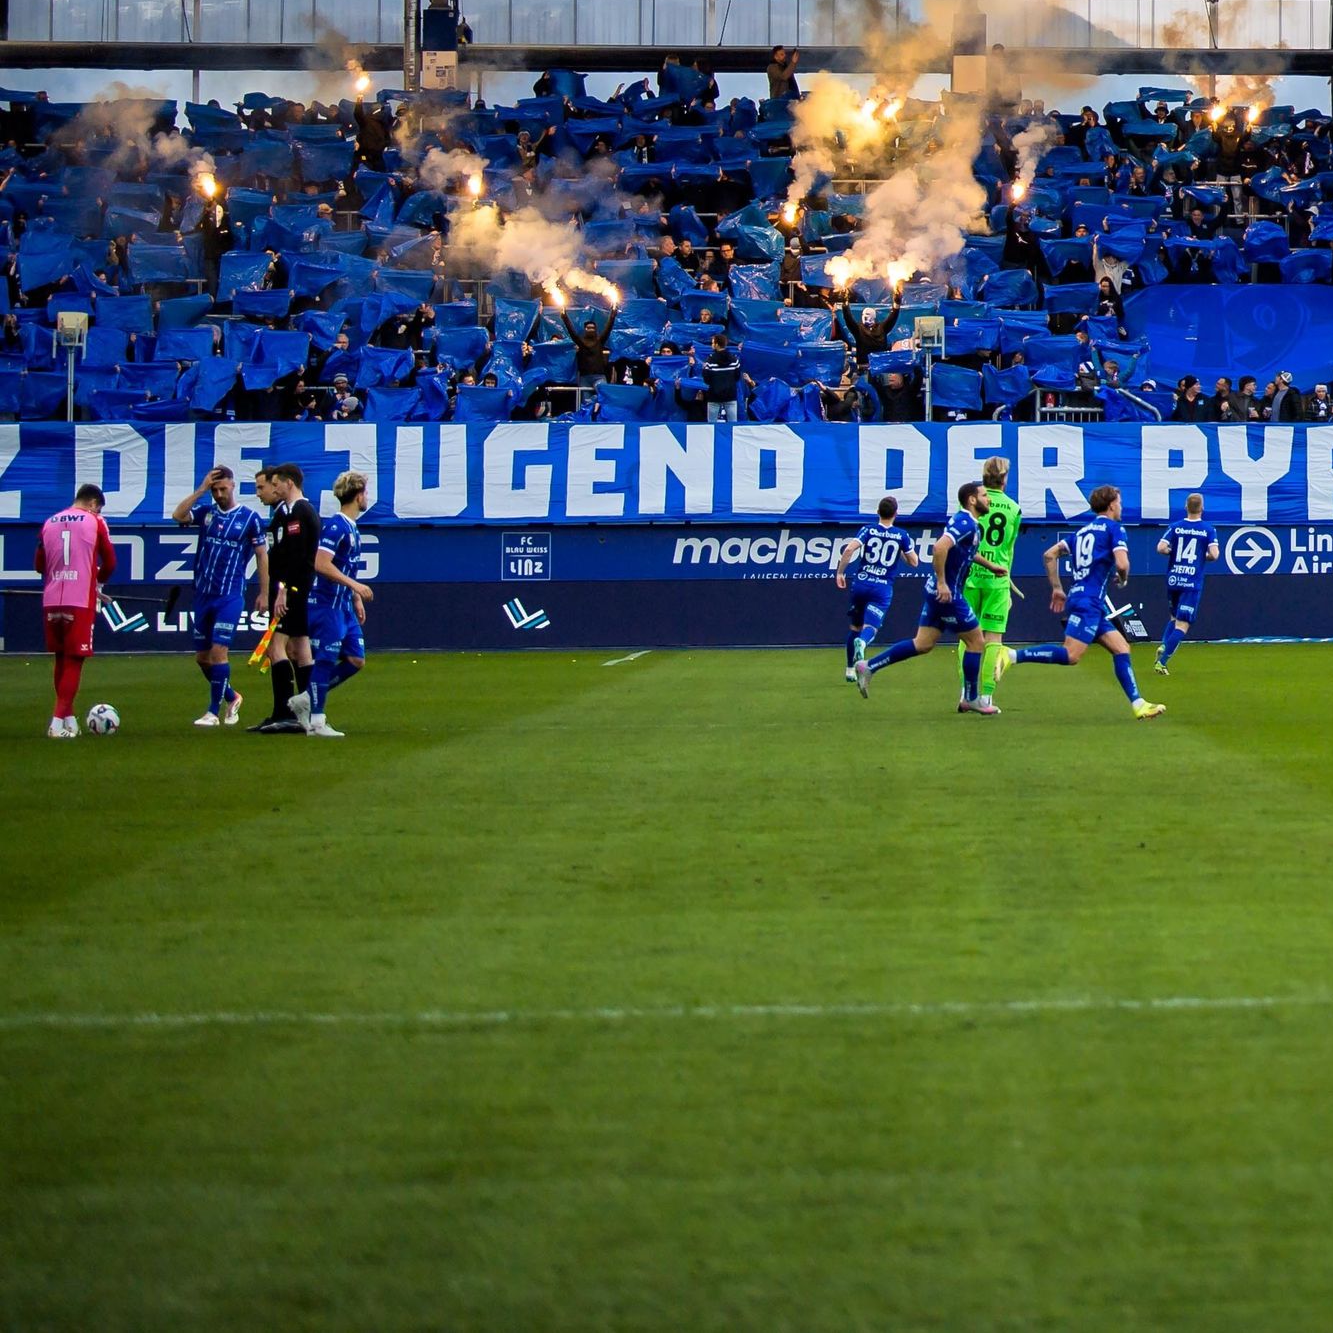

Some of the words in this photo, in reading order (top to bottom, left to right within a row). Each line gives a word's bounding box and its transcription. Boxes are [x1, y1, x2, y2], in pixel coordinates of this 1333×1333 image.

[75, 422, 272, 519] DIE
[319, 422, 804, 519] JUGEND
[858, 423, 1093, 519] DER
[520, 536, 533, 546] FC
[869, 528, 902, 541] Oberbank
[1175, 527, 1207, 537] Oberbank
[62, 531, 71, 566] 1
[505, 546, 524, 554] BLAU
[526, 546, 548, 554] WEISS
[672, 529, 938, 570] machspt
[865, 537, 899, 567] 30
[1075, 532, 1096, 570] 19
[1175, 537, 1197, 564] 14
